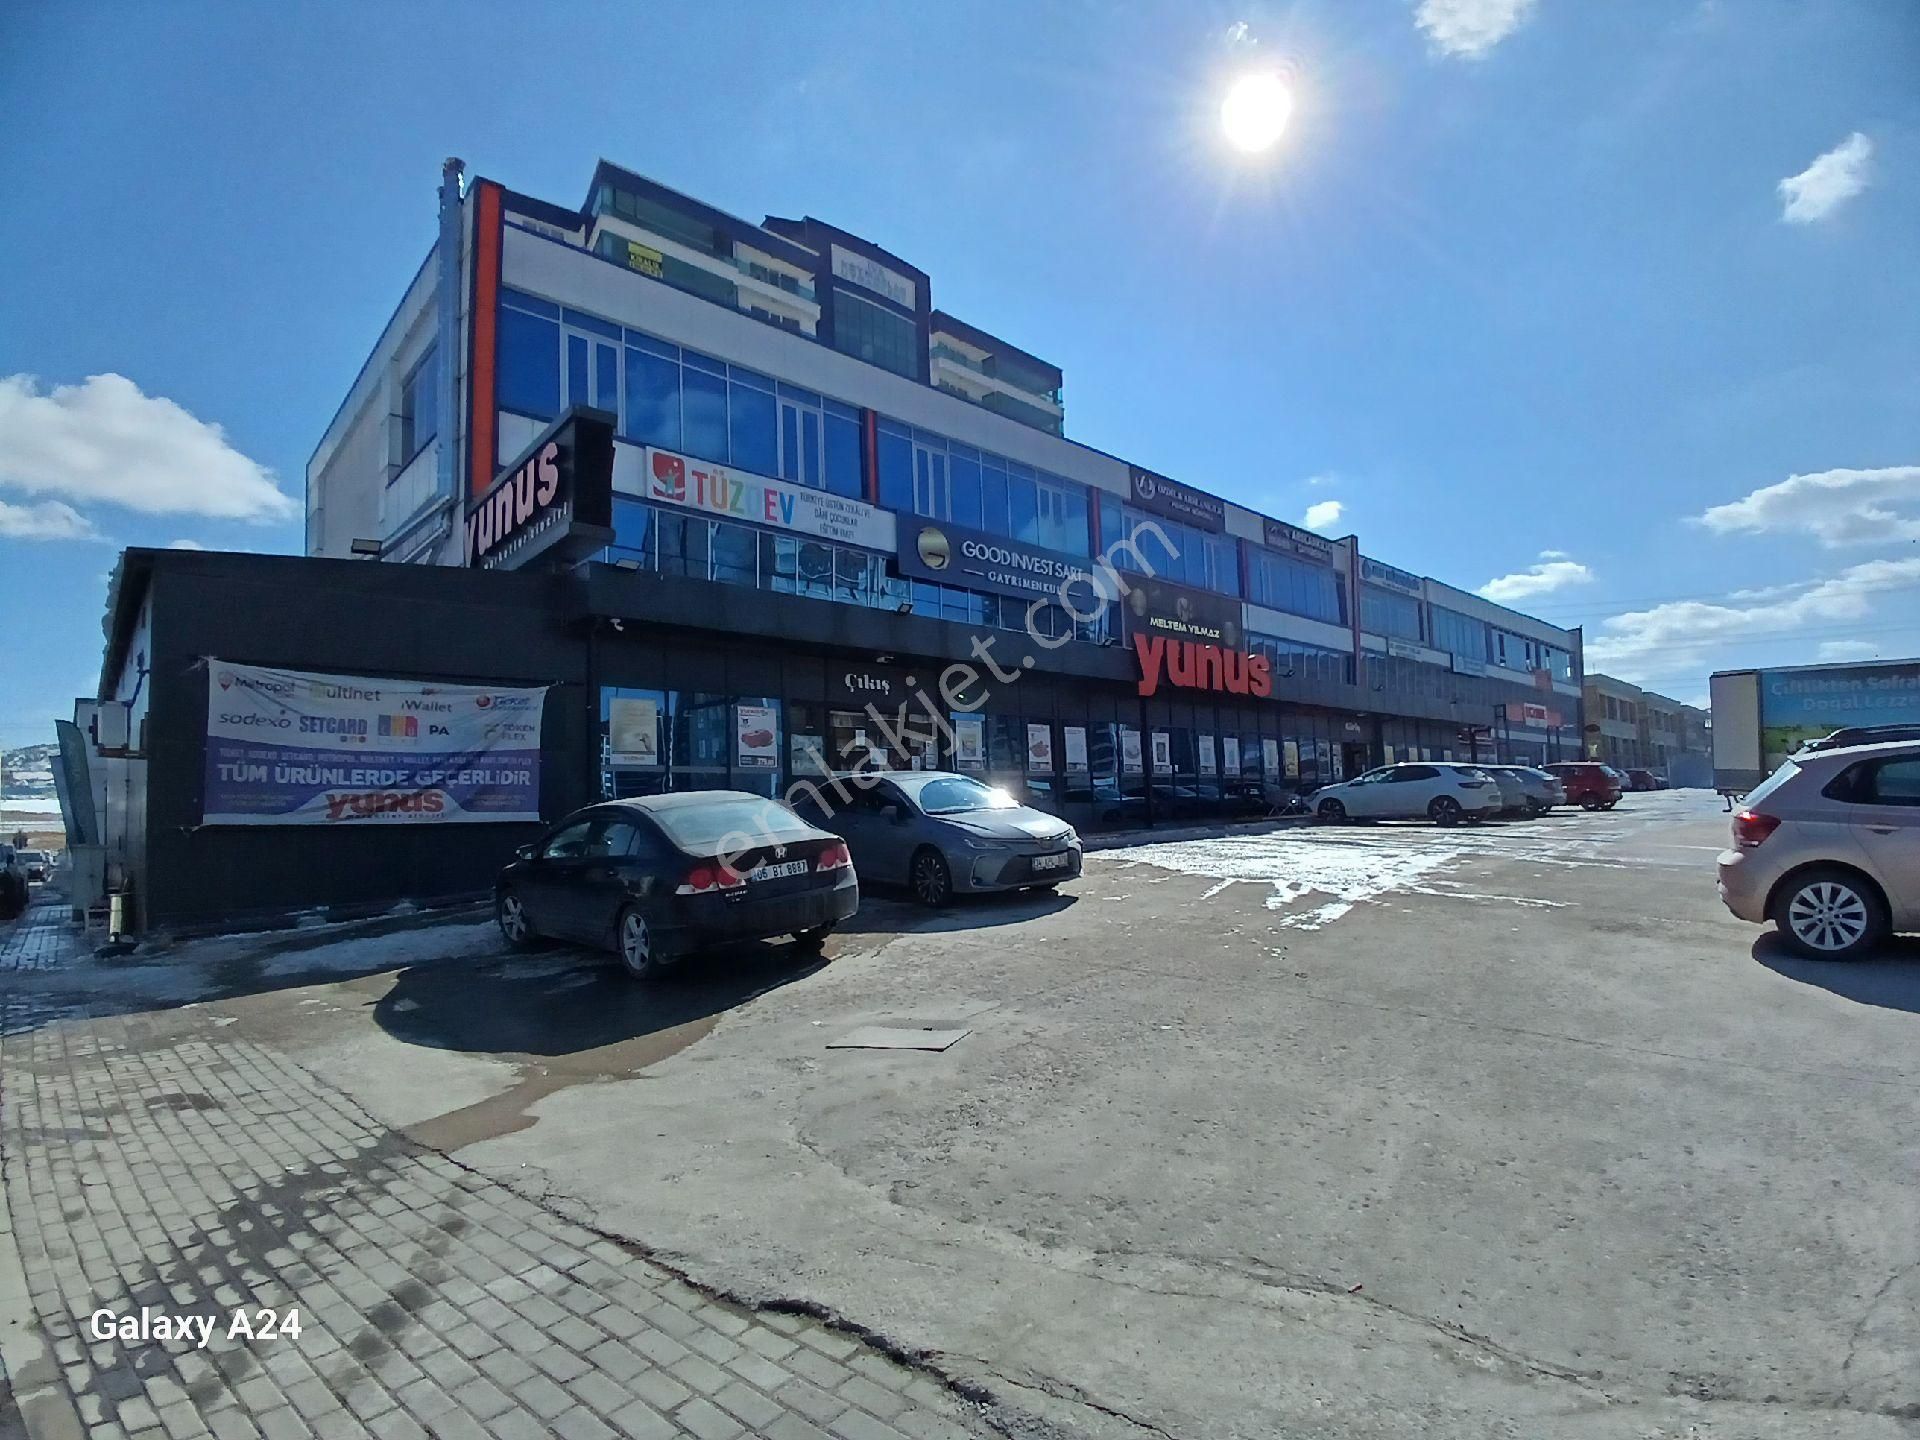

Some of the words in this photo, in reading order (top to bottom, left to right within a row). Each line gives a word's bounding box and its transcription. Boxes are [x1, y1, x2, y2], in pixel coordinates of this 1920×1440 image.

[1150, 617, 1187, 633] MELTEM
[1188, 624, 1220, 639] YILMAZ
[1133, 632, 1272, 697] yunus
[845, 673, 890, 695] Çıkış
[218, 712, 292, 729] sodexo
[299, 715, 368, 735] SETCARD
[217, 760, 268, 783] TÜM
[275, 762, 409, 786] ÜRÜNLERDE
